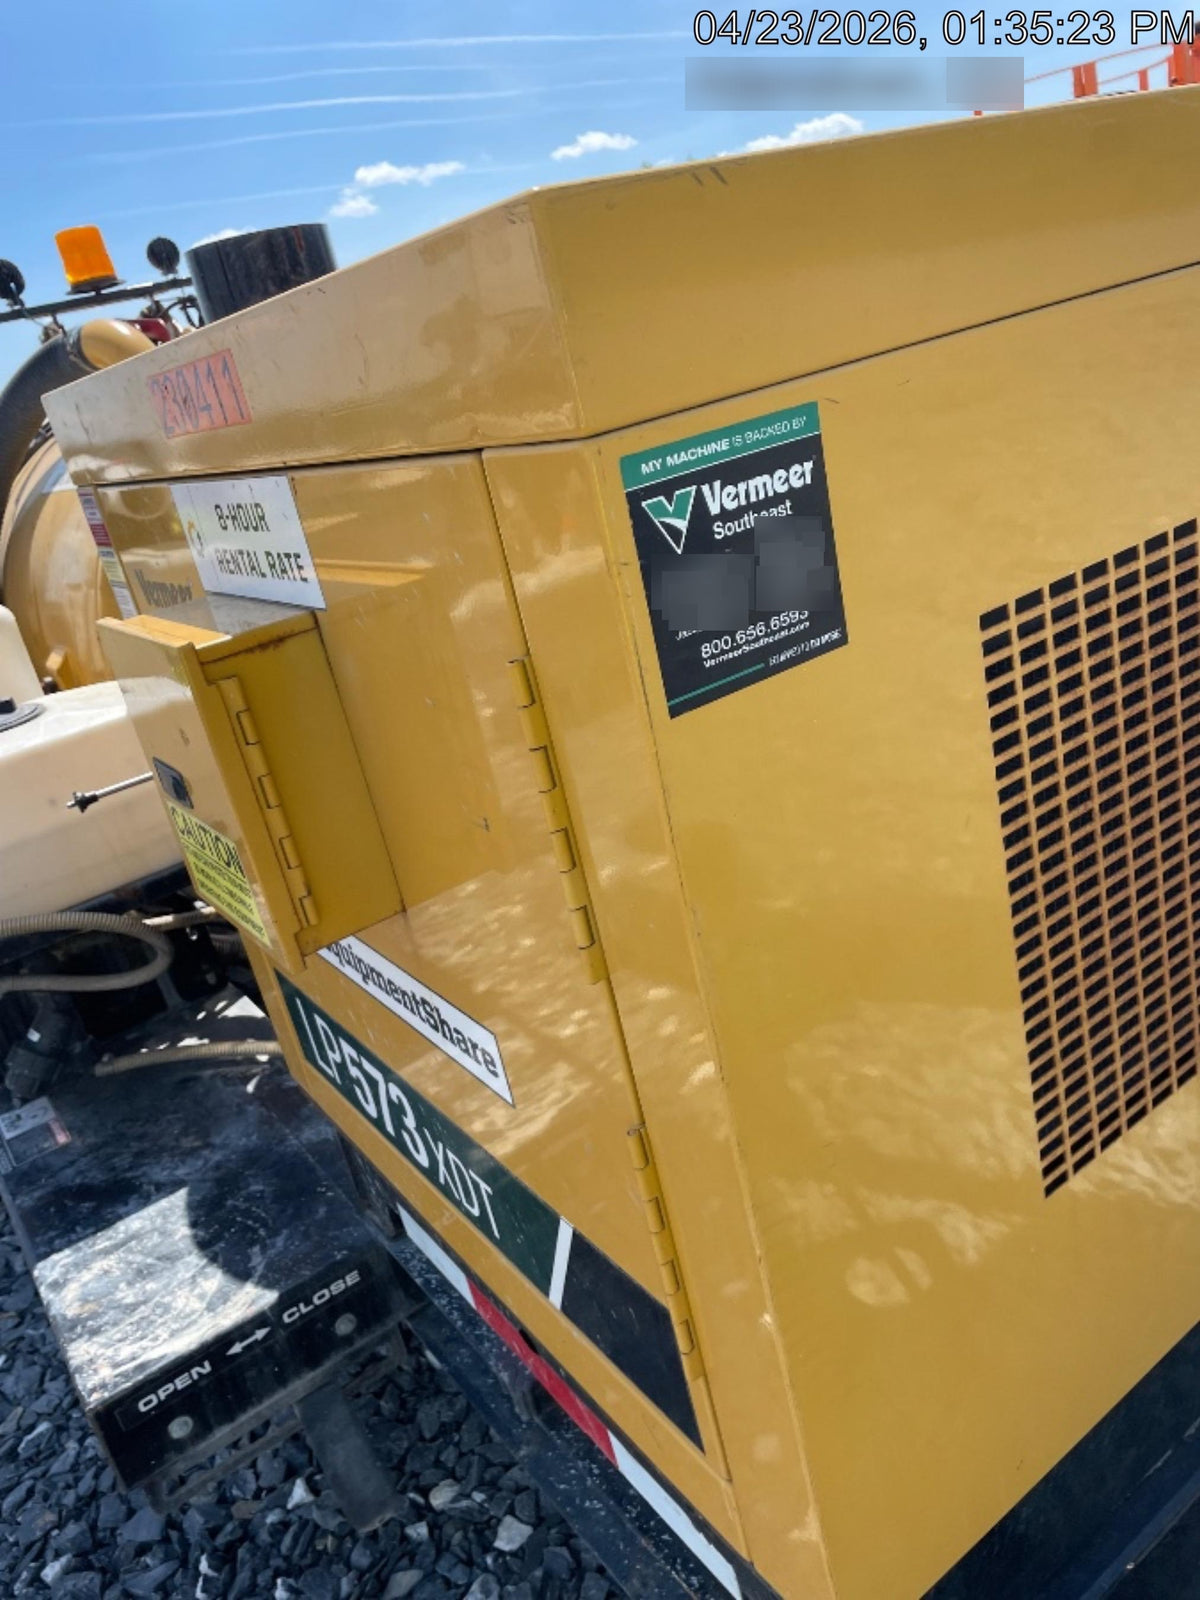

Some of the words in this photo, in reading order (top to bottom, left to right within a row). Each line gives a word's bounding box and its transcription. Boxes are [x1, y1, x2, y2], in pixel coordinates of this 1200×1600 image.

[641, 458, 662, 475] MY
[666, 439, 730, 467] MACHINE
[732, 435, 742, 447] IS
[744, 421, 790, 444] BACKED
[792, 416, 807, 429] BY
[701, 459, 813, 516] Vermeer
[214, 502, 271, 532] 8-HOUR
[215, 549, 267, 579] RENTAL
[264, 551, 308, 583] RATE
[326, 941, 499, 1078] quipmentShare
[282, 1270, 361, 1324] CLOSE
[138, 1360, 212, 1413] OPEN
